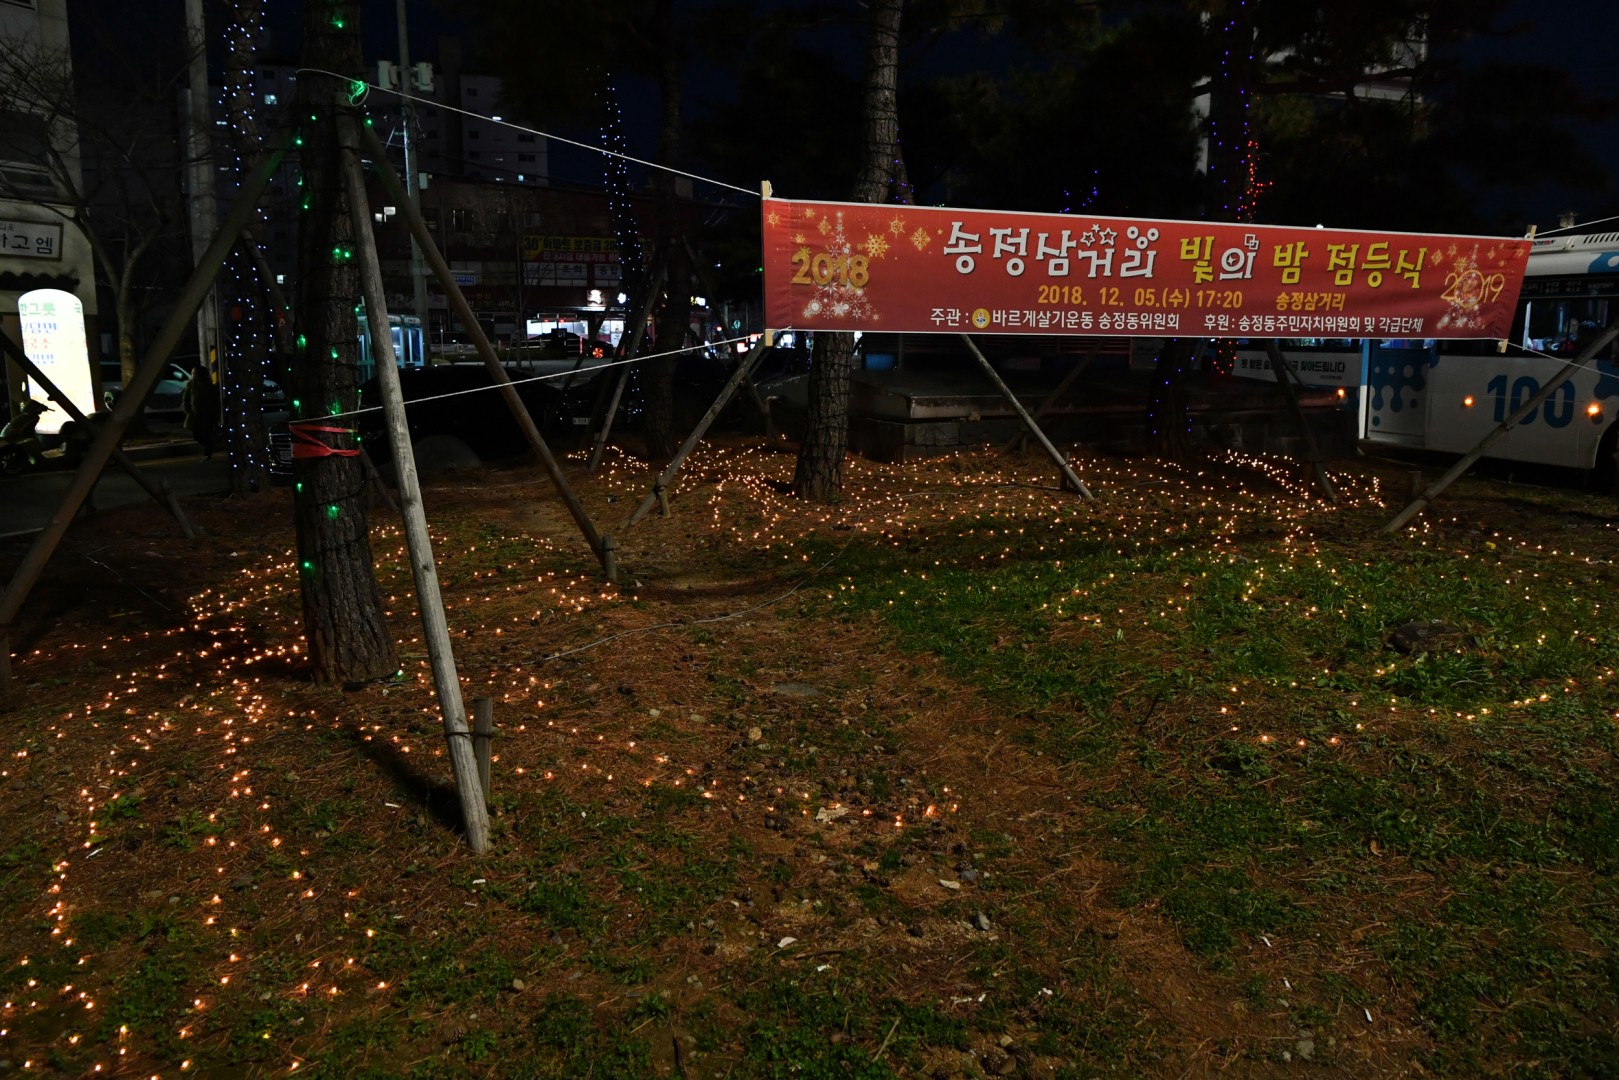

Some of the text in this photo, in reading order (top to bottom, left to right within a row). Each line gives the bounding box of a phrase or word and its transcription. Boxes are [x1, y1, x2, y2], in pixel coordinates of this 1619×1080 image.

[942, 221, 1429, 289] 송정삼거리 빛의 밤 점등식
[791, 253, 870, 288] 2018
[1037, 285, 1088, 306] 2018.
[1099, 287, 1124, 307] 12.
[1195, 290, 1243, 308] 17:20
[1275, 291, 1345, 312] 송정삼거리
[992, 309, 1093, 330] 바르게살기운동
[1098, 311, 1180, 331] 송정동위원회
[1238, 314, 1360, 333] 송정동주민자치위원회
[1364, 317, 1375, 333] 및
[1379, 317, 1424, 334] 각급단체
[1300, 360, 1346, 374] 찾아드립니다
[1487, 374, 1576, 429] 100
